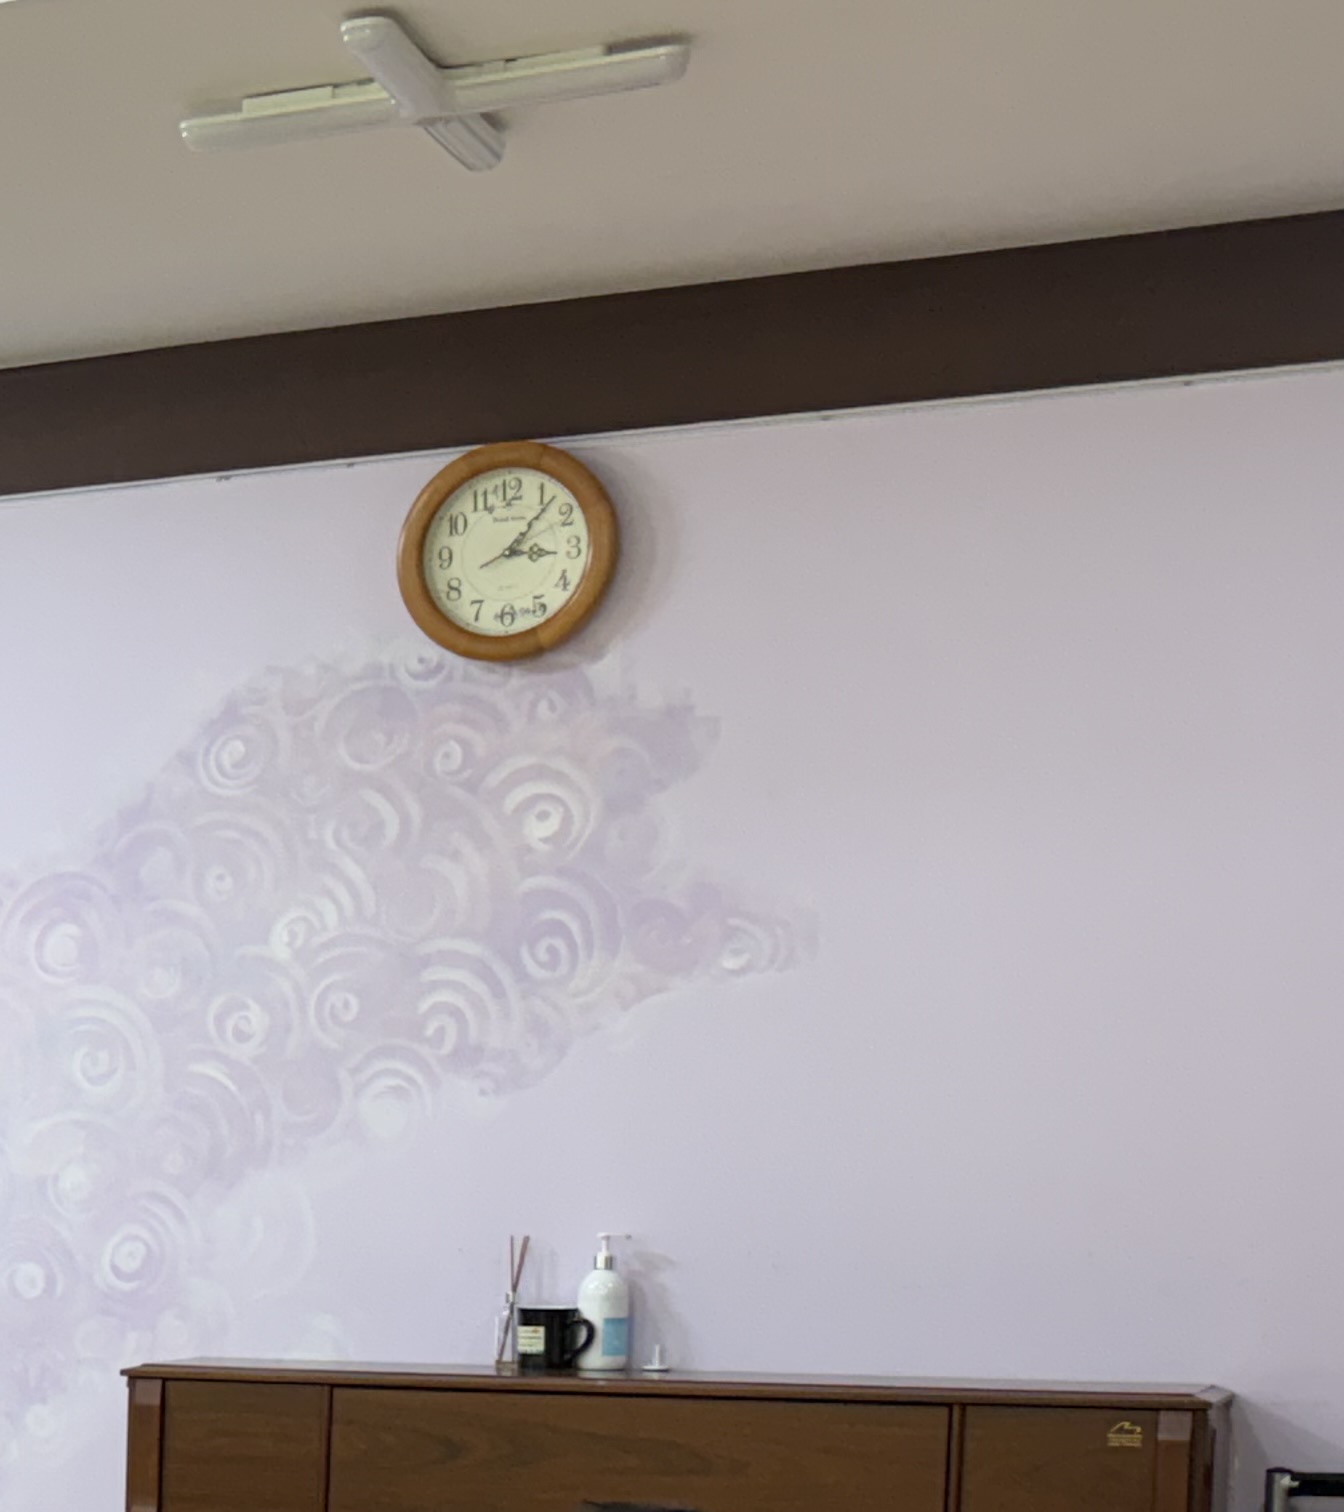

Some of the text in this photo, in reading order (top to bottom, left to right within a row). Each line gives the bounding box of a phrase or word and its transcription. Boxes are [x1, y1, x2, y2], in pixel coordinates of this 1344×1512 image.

[473, 488, 489, 513] 11
[501, 477, 523, 502] 12
[537, 482, 545, 506] 1
[448, 512, 468, 537] 10
[558, 502, 575, 527] 2
[438, 546, 453, 570] 9
[566, 535, 582, 560] 3
[446, 577, 462, 602] 8
[554, 569, 570, 591] 4
[470, 599, 484, 623] 7
[499, 603, 515, 627] 6
[532, 594, 548, 618] 5
